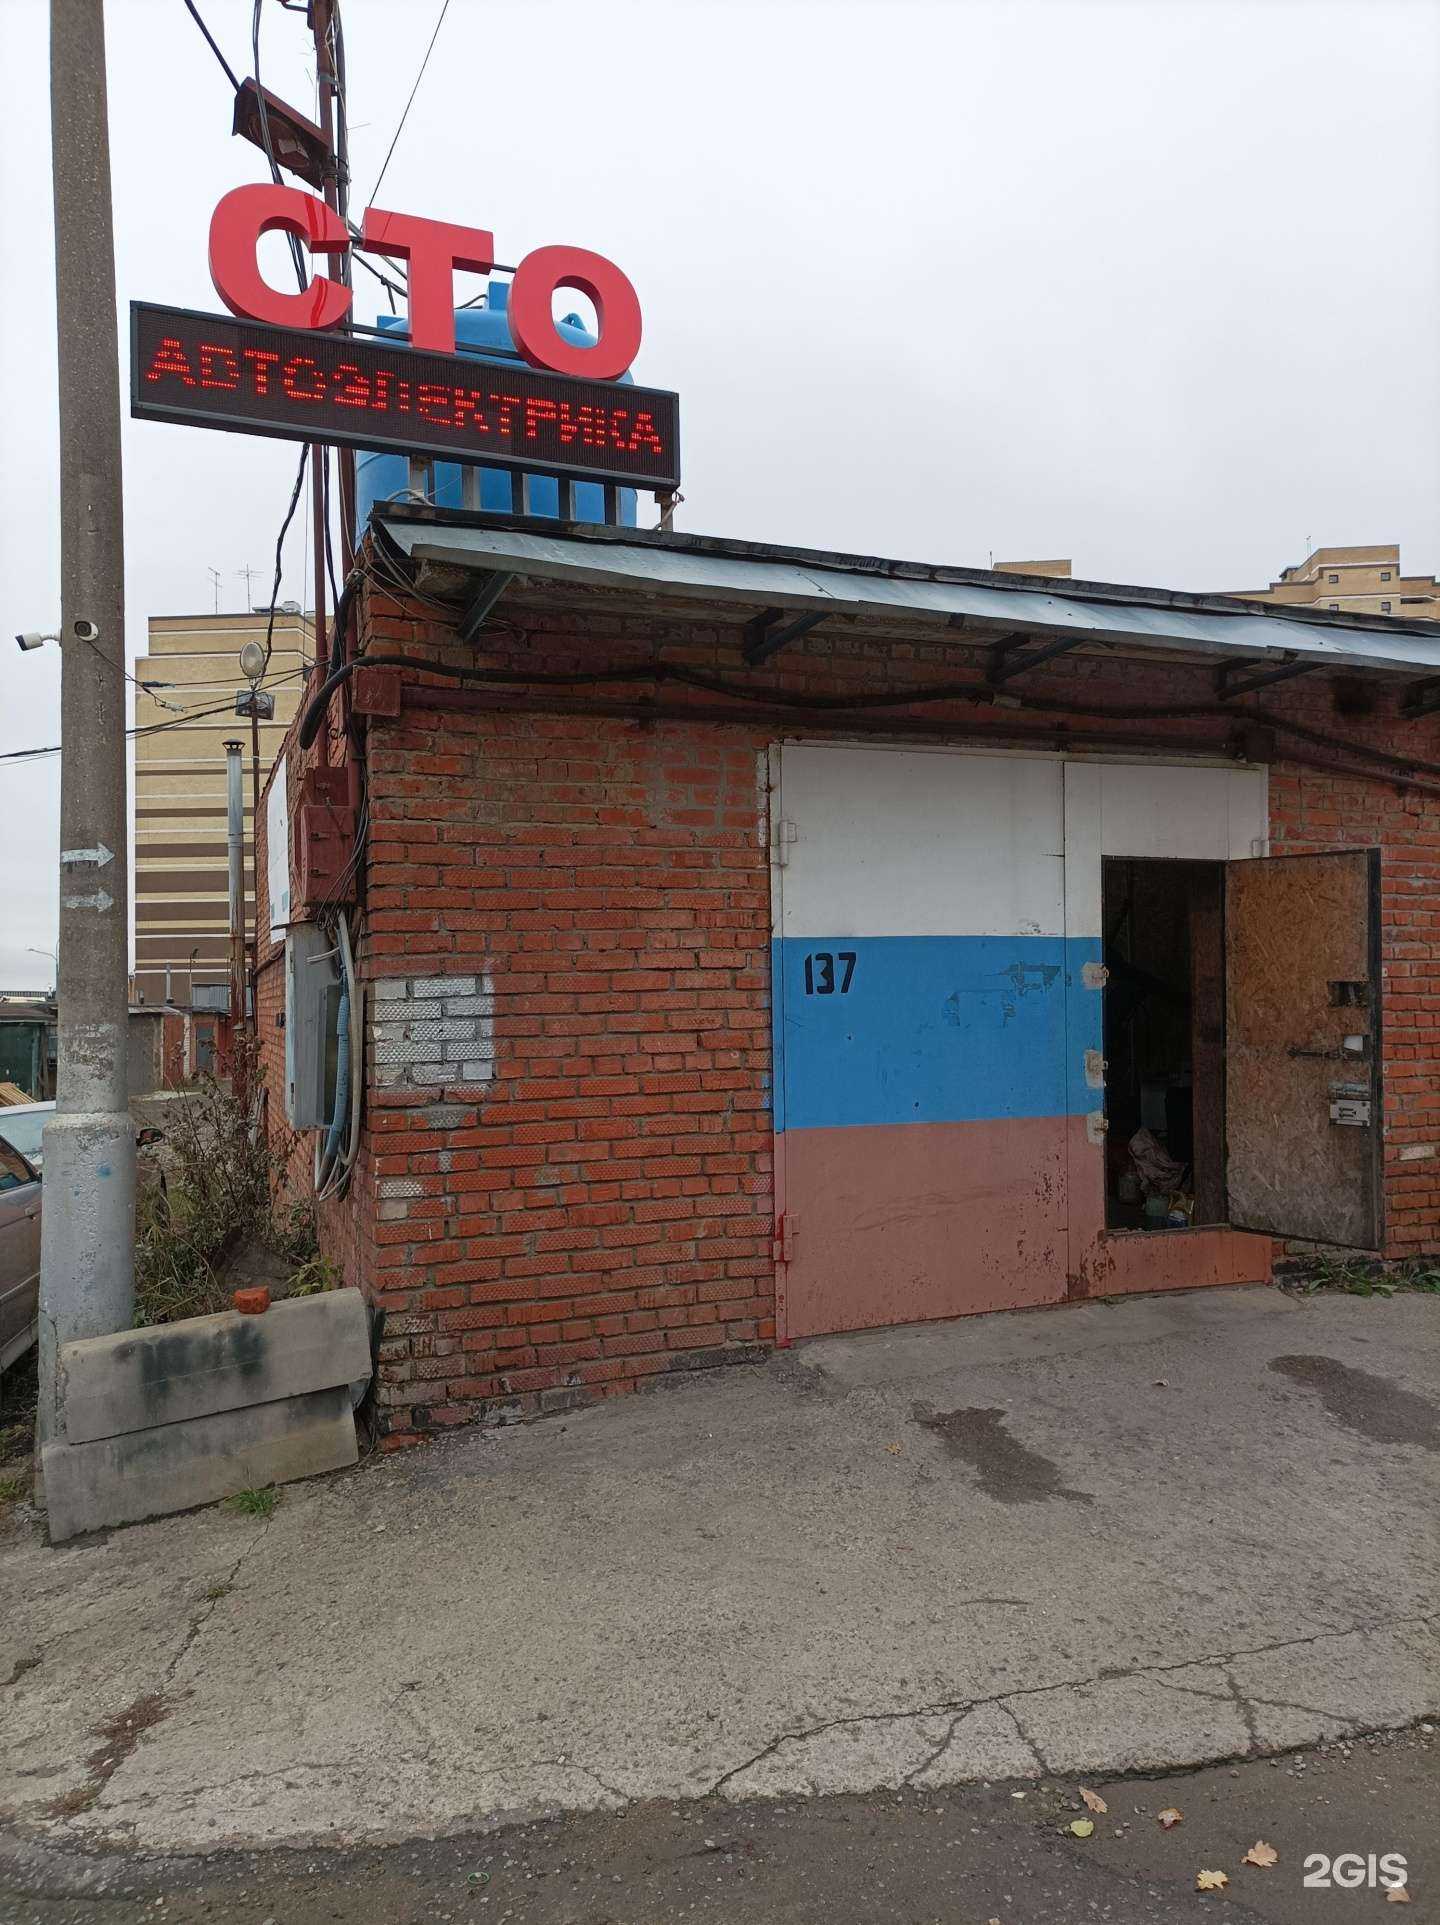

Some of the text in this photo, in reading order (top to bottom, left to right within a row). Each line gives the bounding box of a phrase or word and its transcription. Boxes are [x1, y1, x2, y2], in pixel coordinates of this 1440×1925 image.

[208, 182, 642, 381] СТО
[146, 335, 664, 454] АВТОЭЛЕКТРИКА
[804, 951, 857, 995] 137
